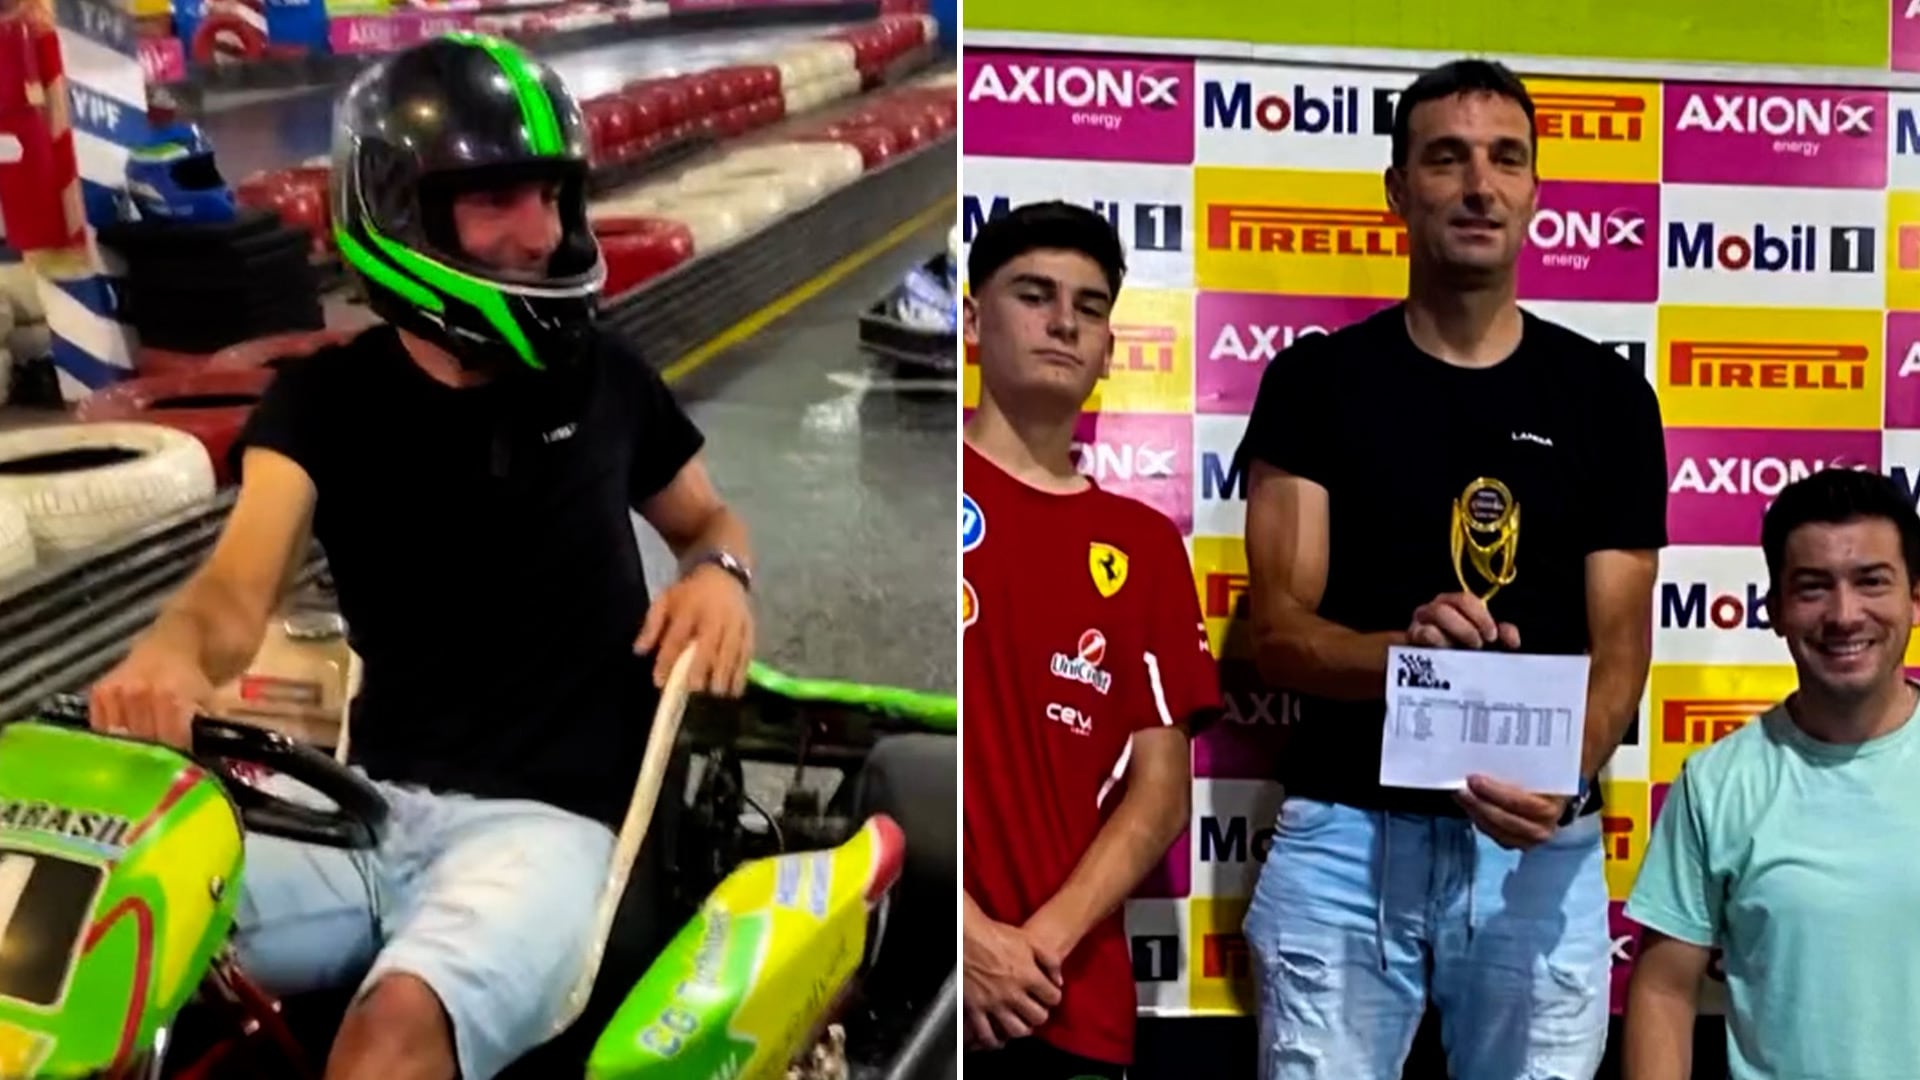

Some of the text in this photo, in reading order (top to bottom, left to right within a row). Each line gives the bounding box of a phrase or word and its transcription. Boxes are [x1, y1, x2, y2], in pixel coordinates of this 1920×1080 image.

[71, 87, 119, 132] YPF
[1072, 112, 1122, 130] energy
[1203, 81, 1358, 135] Mobil
[1533, 92, 1646, 142] ELLI
[1772, 138, 1820, 156] energy
[1208, 203, 1409, 256] PIRELLI
[1667, 221, 1816, 272] Mobil
[1542, 252, 1590, 270] energy
[1208, 323, 1330, 362] AXI
[1669, 340, 1869, 390] PIRELLI
[1659, 583, 1770, 630] Mob
